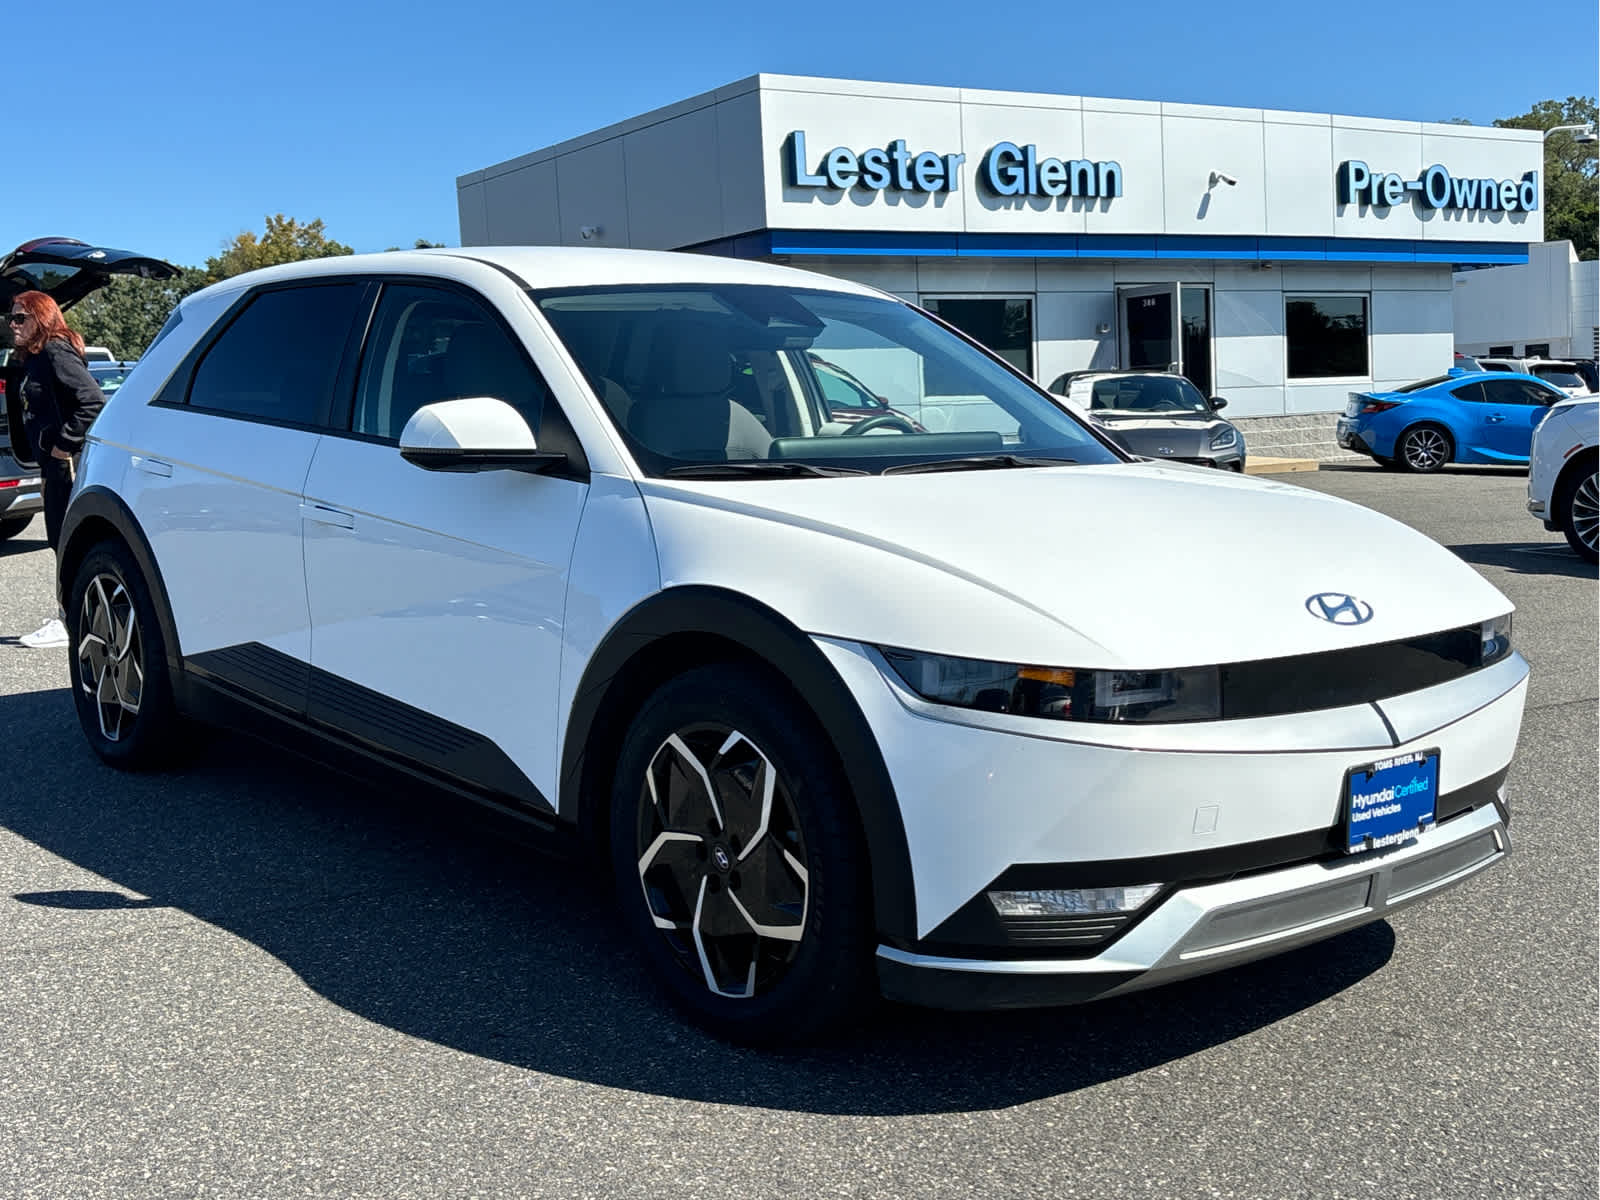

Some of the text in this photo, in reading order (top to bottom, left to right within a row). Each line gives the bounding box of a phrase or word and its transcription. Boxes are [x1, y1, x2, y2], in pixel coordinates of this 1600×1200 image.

[789, 130, 1123, 198] Lester Glenn
[1343, 159, 1538, 212] Pre-Owned
[1374, 759, 1394, 771] TOMS
[1351, 803, 1402, 823] Used Vehicles
